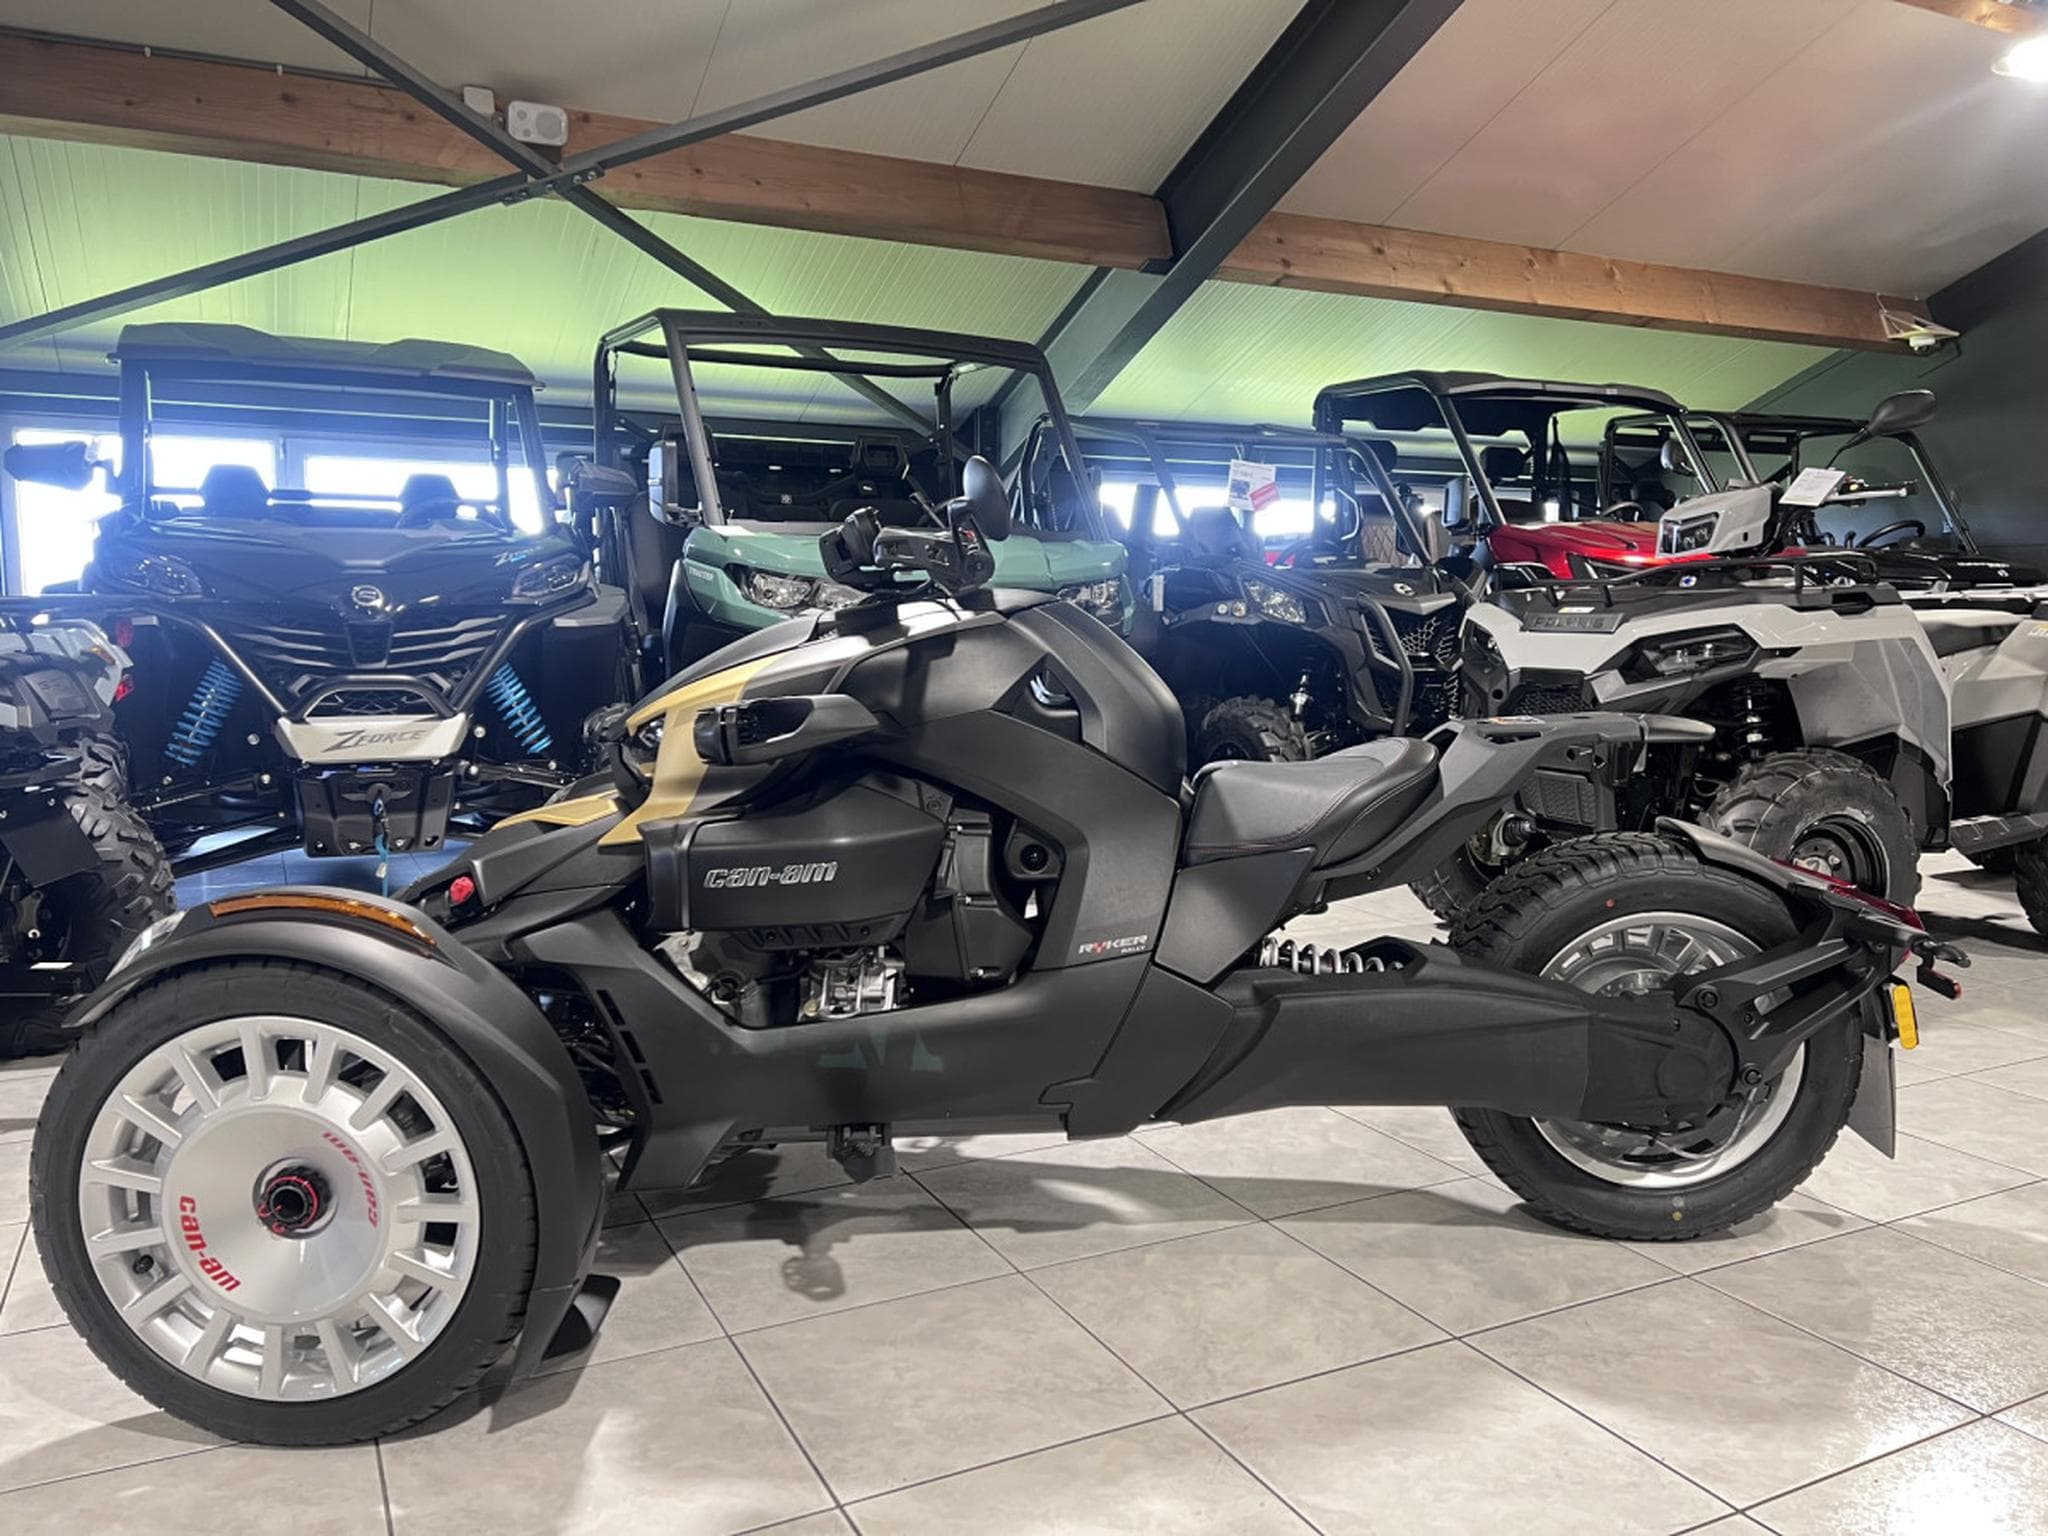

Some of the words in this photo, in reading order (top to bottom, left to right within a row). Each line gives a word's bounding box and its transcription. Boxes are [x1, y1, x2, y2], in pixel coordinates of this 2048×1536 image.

[321, 729, 428, 753] ZFORCE
[703, 861, 838, 888] can-am
[1078, 935, 1148, 954] RYKER
[179, 1195, 241, 1292] can-am
